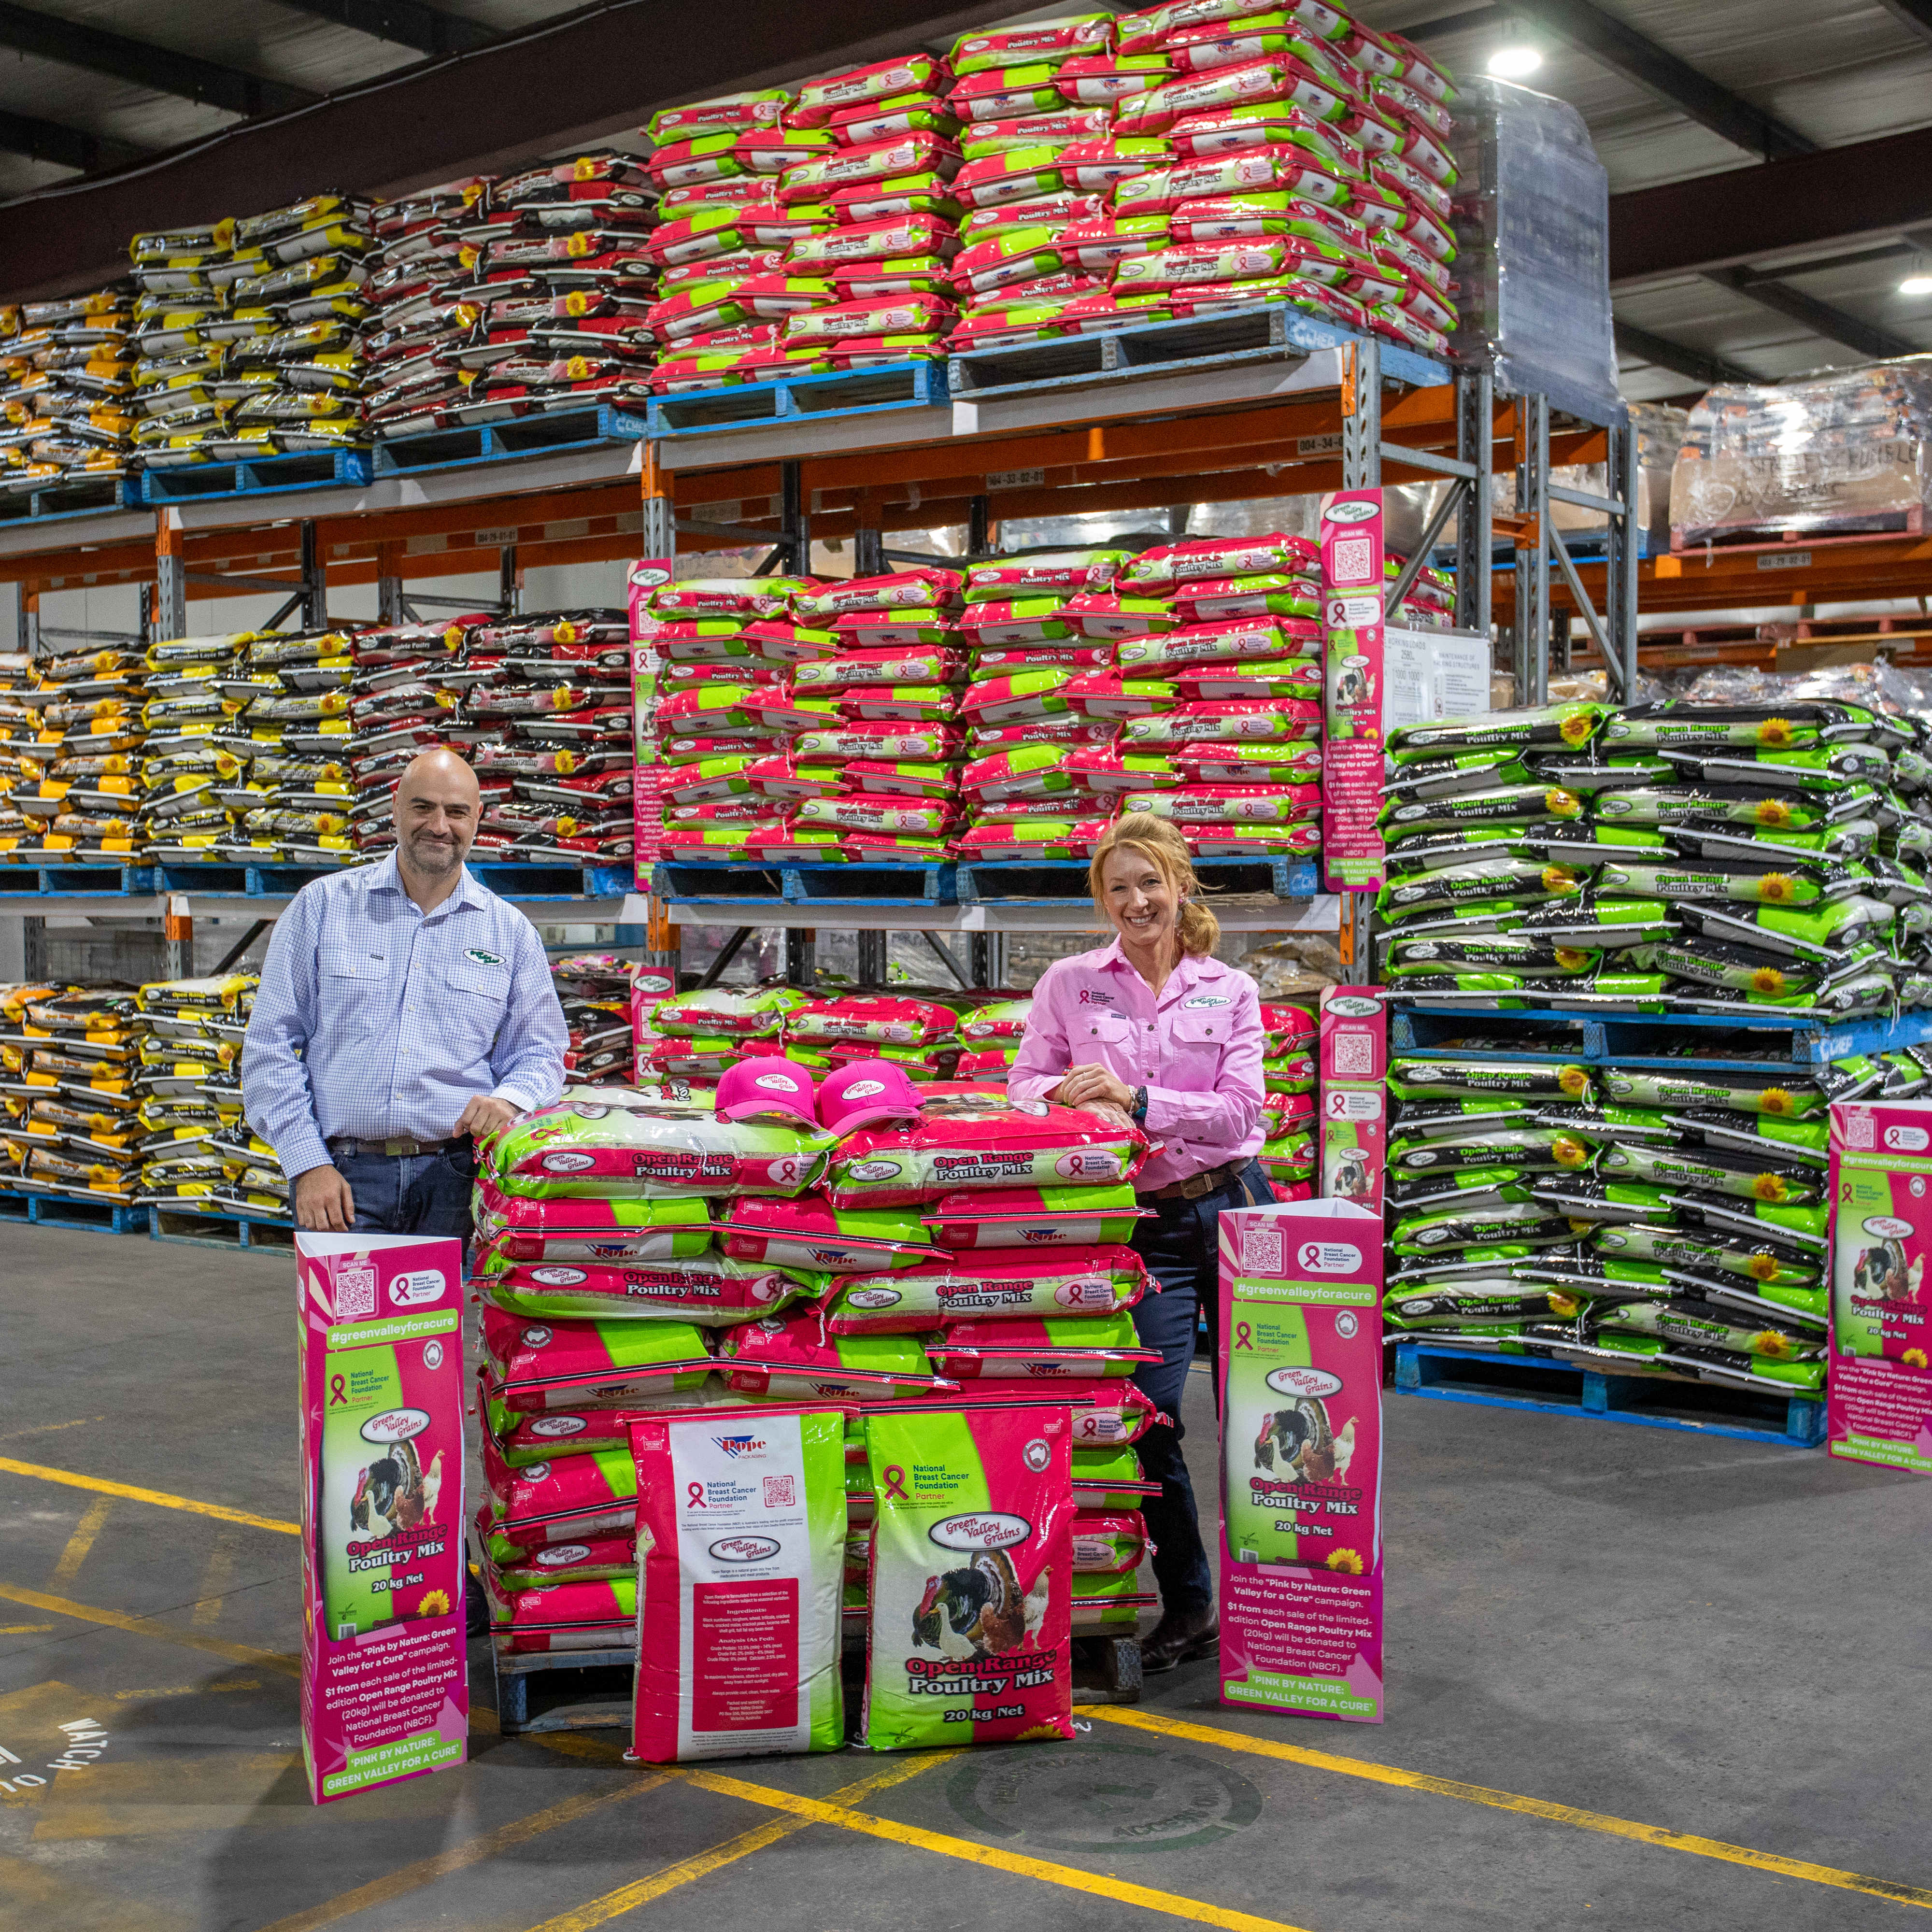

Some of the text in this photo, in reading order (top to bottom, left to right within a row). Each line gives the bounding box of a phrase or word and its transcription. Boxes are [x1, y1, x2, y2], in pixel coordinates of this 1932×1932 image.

[838, 743, 865, 752] Poultry
[1452, 796, 1519, 810] Open Range
[1454, 802, 1518, 819] Poultry Mix
[845, 1083, 882, 1095] Green Valley Grains
[1467, 1079, 1532, 1089] Poultry Mix
[632, 1153, 734, 1166] Open Range
[935, 1152, 1034, 1168] Open Range
[635, 1165, 731, 1178] Poultry Mix
[938, 1163, 1033, 1180] Poultry Mix
[815, 1250, 857, 1264] Pope
[1237, 1283, 1372, 1301] #greenvalleyforacure
[331, 1317, 455, 1344] #greenvalleyforacure
[1278, 1371, 1333, 1394] Green Valley Grains
[722, 1439, 767, 1452] Pope
[1250, 1477, 1363, 1501] Open Range
[1252, 1492, 1359, 1515] Poultry Mix
[946, 1518, 1021, 1546] Green Valley Grains
[1275, 1520, 1333, 1536] 20 kg Net
[346, 1524, 448, 1557] Open Range
[721, 1539, 771, 1559] Green Valley Grains
[349, 1541, 445, 1572] Poultry Mix
[371, 1572, 424, 1593] 20 kg Net
[1229, 1575, 1371, 1596] Join the "Pink by Nature: Green
[1234, 1587, 1262, 1599] Valley
[1264, 1590, 1277, 1599] for
[1286, 1593, 1313, 1602] Cure"
[1315, 1598, 1364, 1608] campaign.
[1228, 1602, 1237, 1610] $1
[1238, 1604, 1261, 1613] from
[1263, 1608, 1284, 1617] each
[1336, 1615, 1372, 1625] limited-
[1228, 1616, 1372, 1638] edition Open Range Poultry Mix
[1243, 1629, 1272, 1640] (20kg)
[1305, 1638, 1344, 1648] donated
[1247, 1642, 1351, 1661] National Breast Cancer
[905, 1649, 1057, 1679] Open Range
[1256, 1655, 1343, 1672] Foundation (NBCF).
[909, 1669, 1055, 1695] Poultry Mix
[1282, 1679, 1296, 1688] BY
[1298, 1682, 1344, 1694] NATURE:
[1228, 1686, 1262, 1698] GREEN
[1264, 1691, 1303, 1704] VALLEY
[1306, 1697, 1327, 1706] FOR
[1329, 1699, 1337, 1707] A
[943, 1704, 1025, 1723] 20 kg Net
[46, 1718, 108, 1770] WATCH
[380, 1748, 393, 1759] BY
[395, 1737, 436, 1755] NATURE:
[327, 1773, 361, 1790] GREEN
[363, 1762, 400, 1779] VALLEY
[402, 1756, 421, 1769] FOR
[423, 1753, 430, 1762] A
